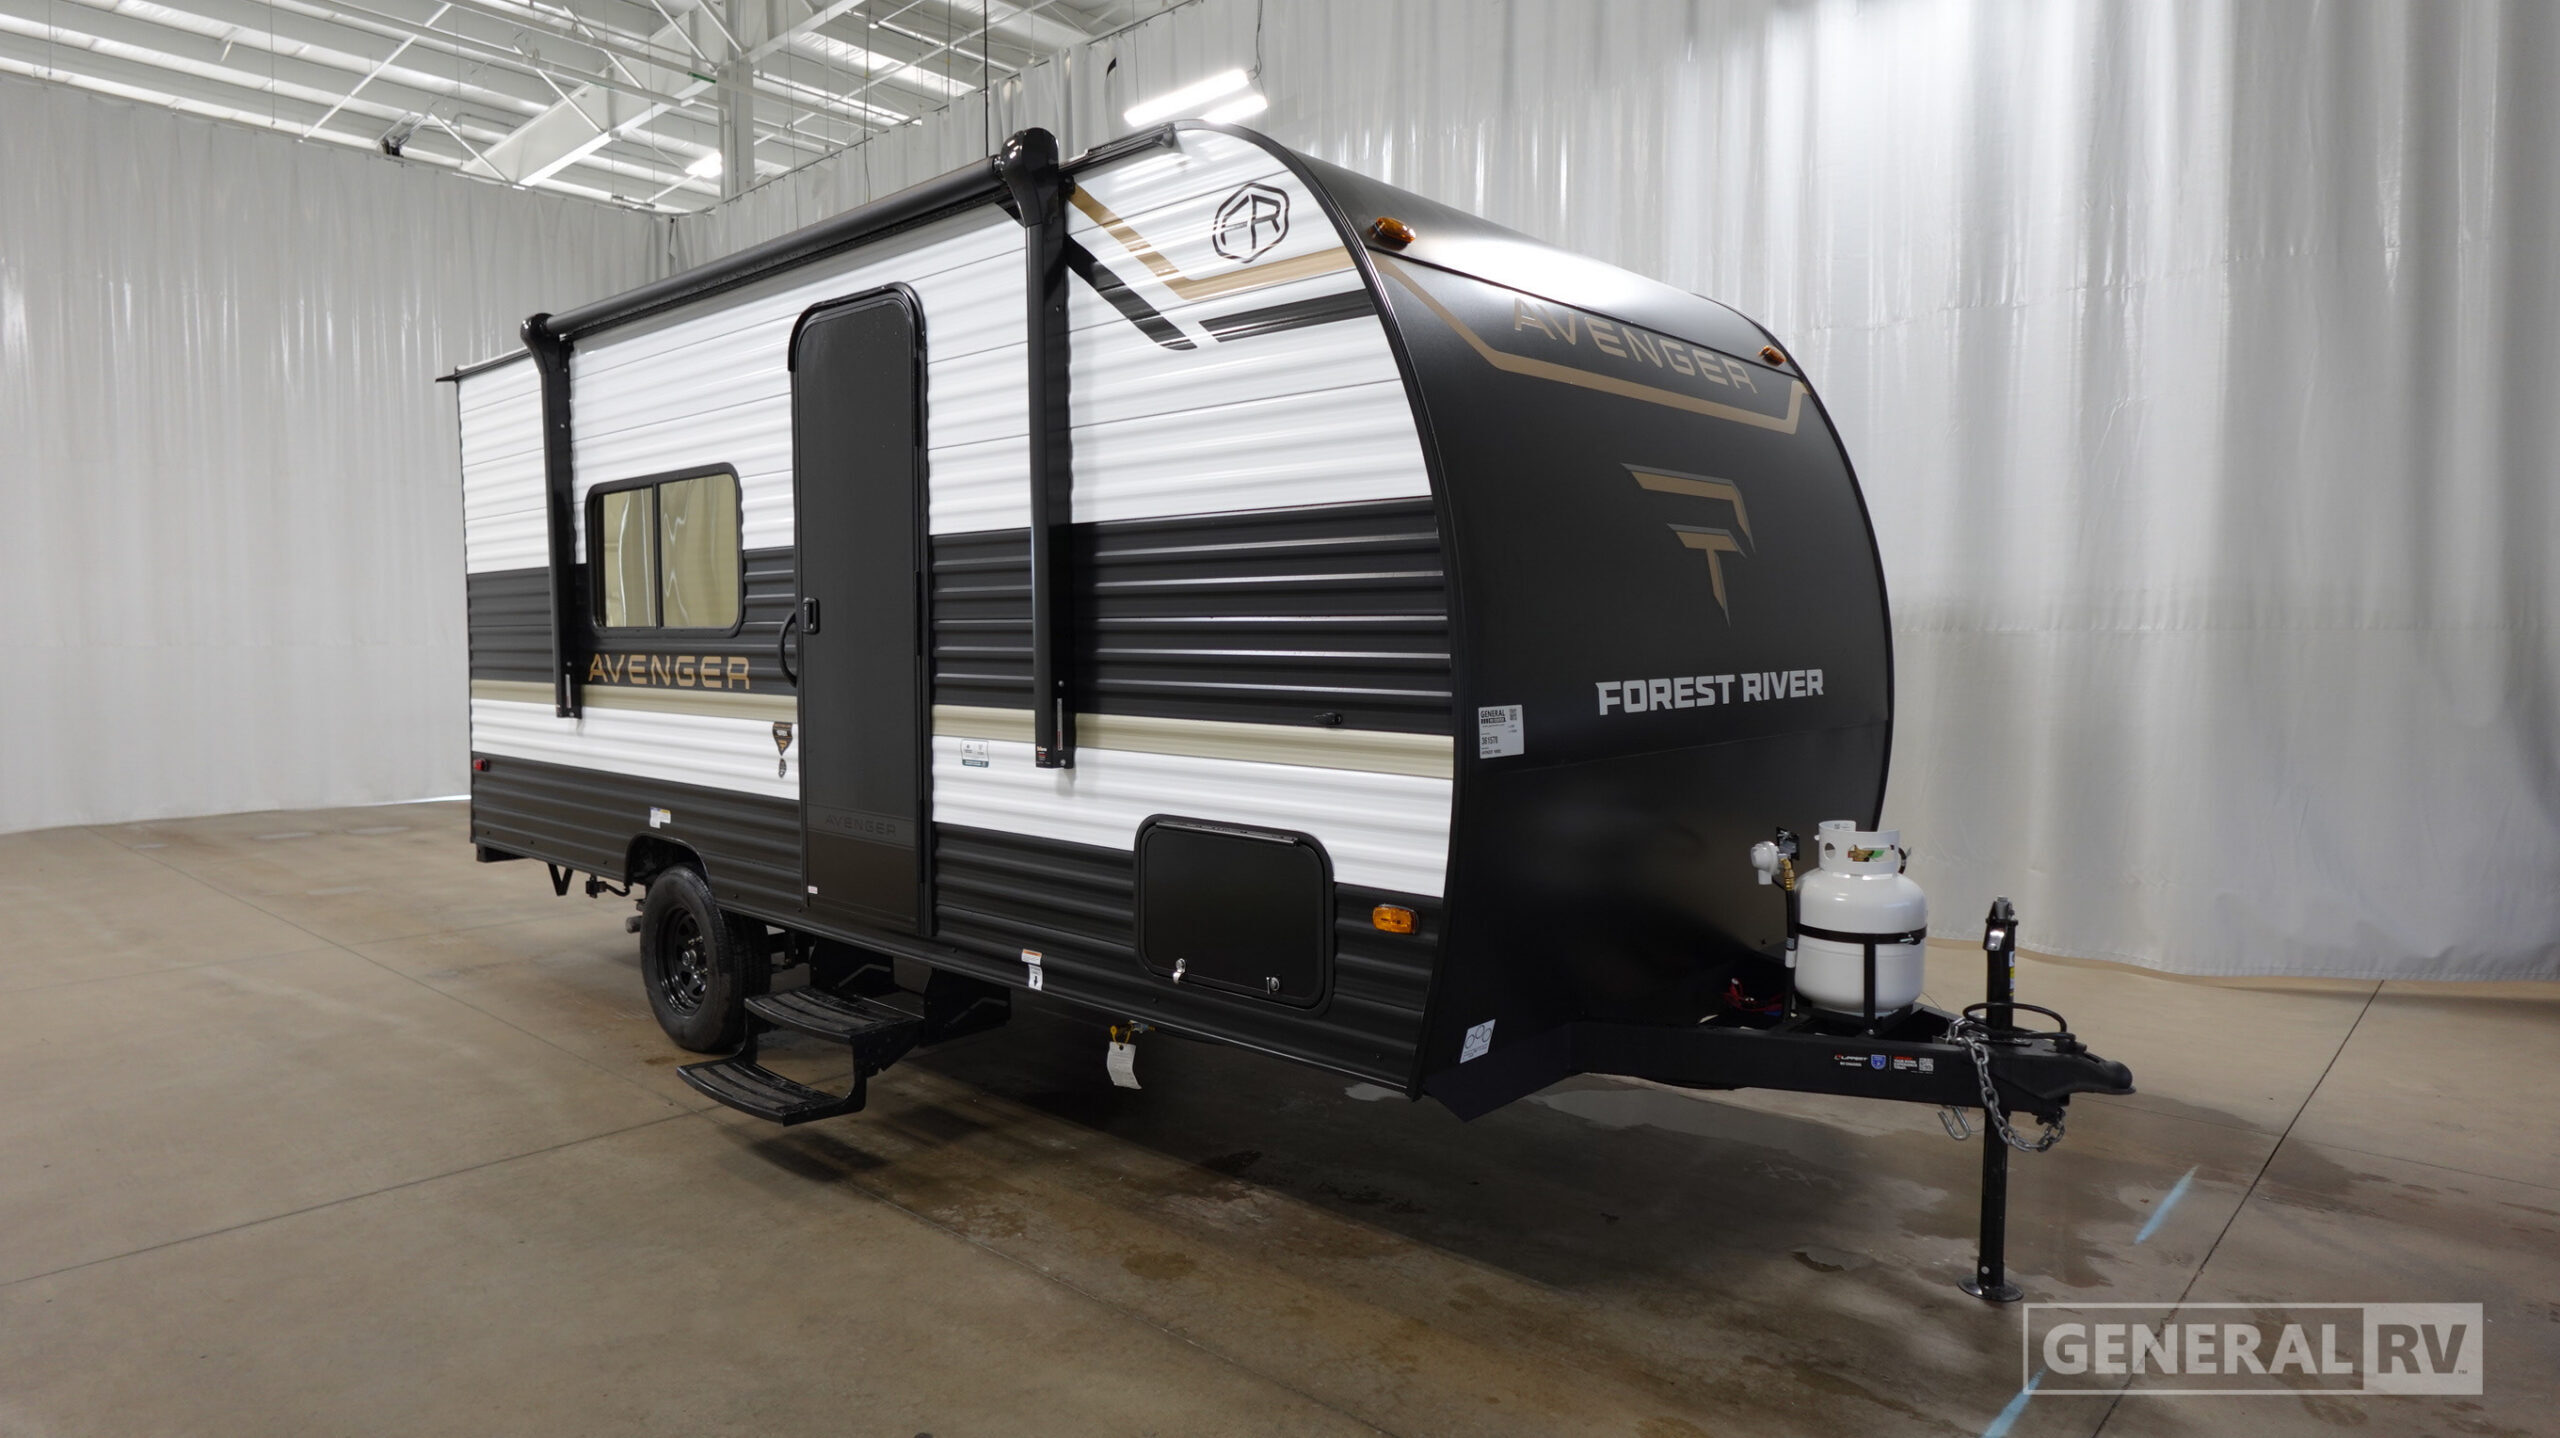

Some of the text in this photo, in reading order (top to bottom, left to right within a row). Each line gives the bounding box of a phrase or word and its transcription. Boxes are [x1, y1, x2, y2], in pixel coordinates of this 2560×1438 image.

[1514, 297, 1758, 394] AVENGER
[588, 653, 750, 690] AVENGER
[1595, 669, 1824, 716] FOREST RIVER
[1480, 709, 1505, 718] GENERAL
[825, 814, 896, 836] AVENGER
